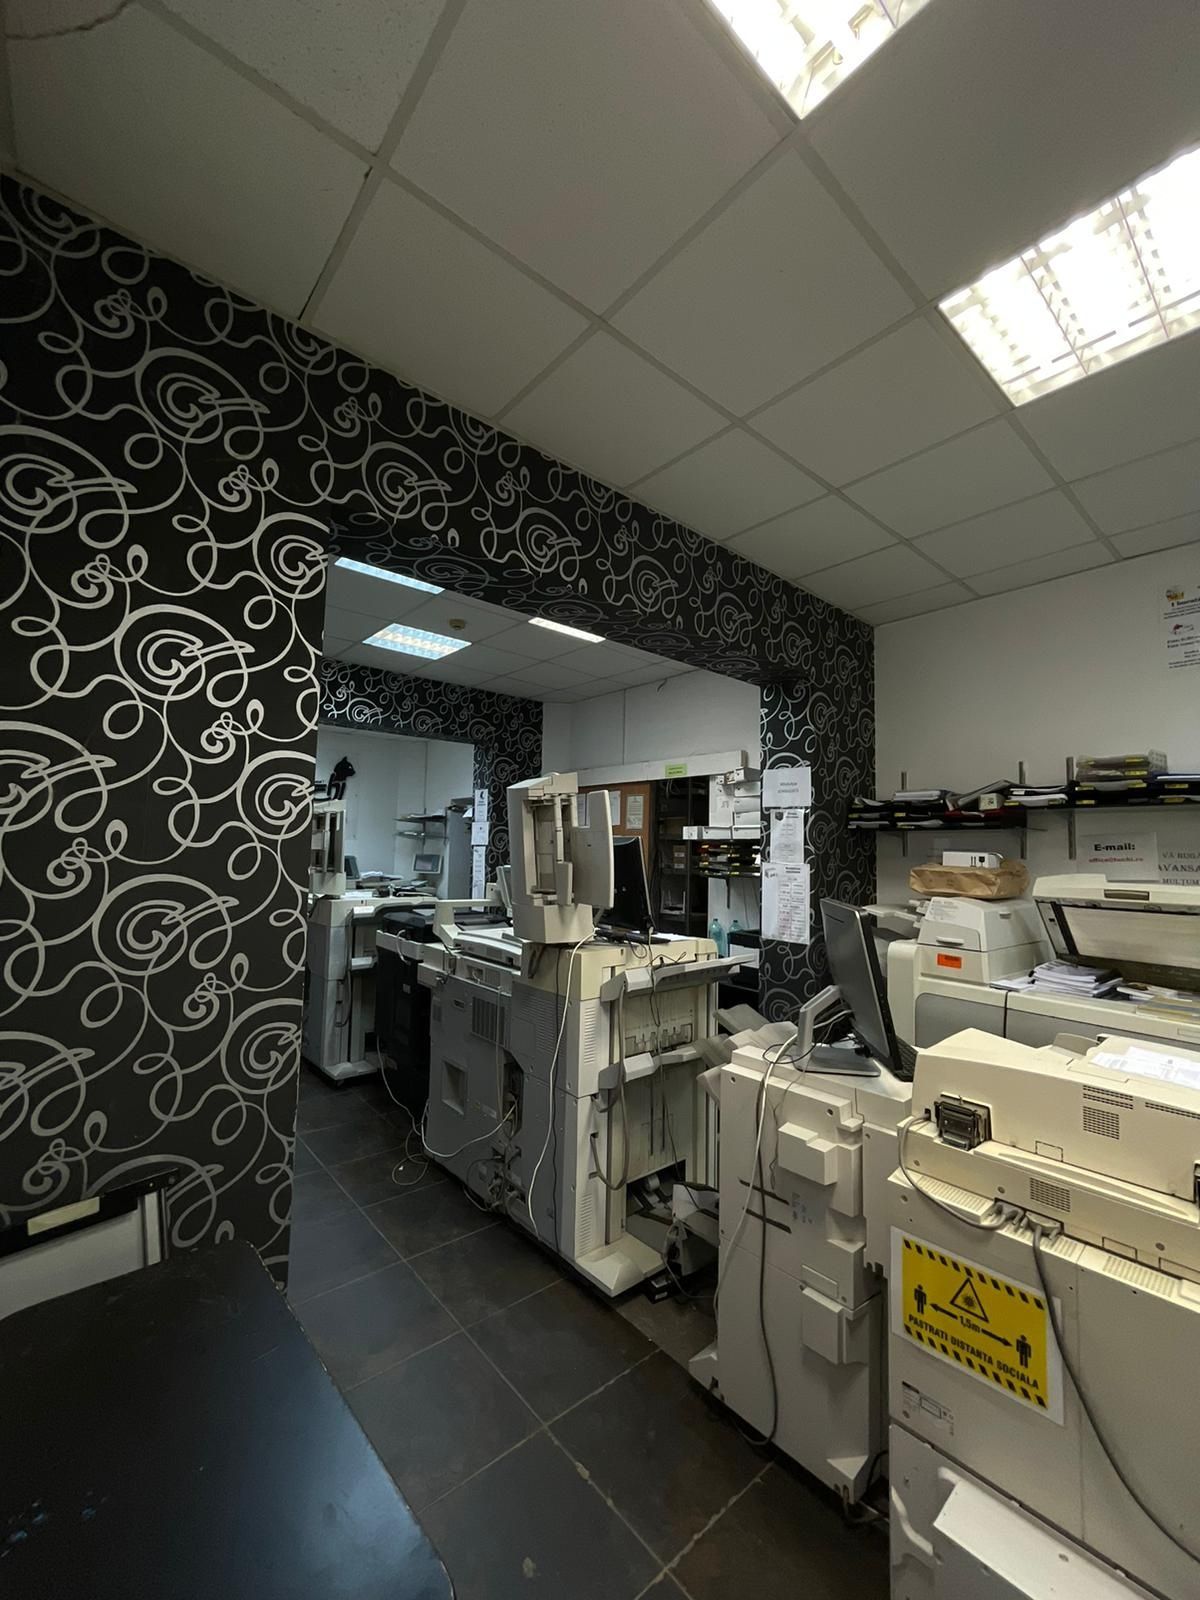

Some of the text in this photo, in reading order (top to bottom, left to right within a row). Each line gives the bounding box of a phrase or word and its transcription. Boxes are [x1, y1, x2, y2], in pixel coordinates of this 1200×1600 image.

[1094, 843, 1136, 851] E-mail:
[950, 1336, 993, 1366] DISTANTA
[996, 1360, 1040, 1390] SOCIALA
